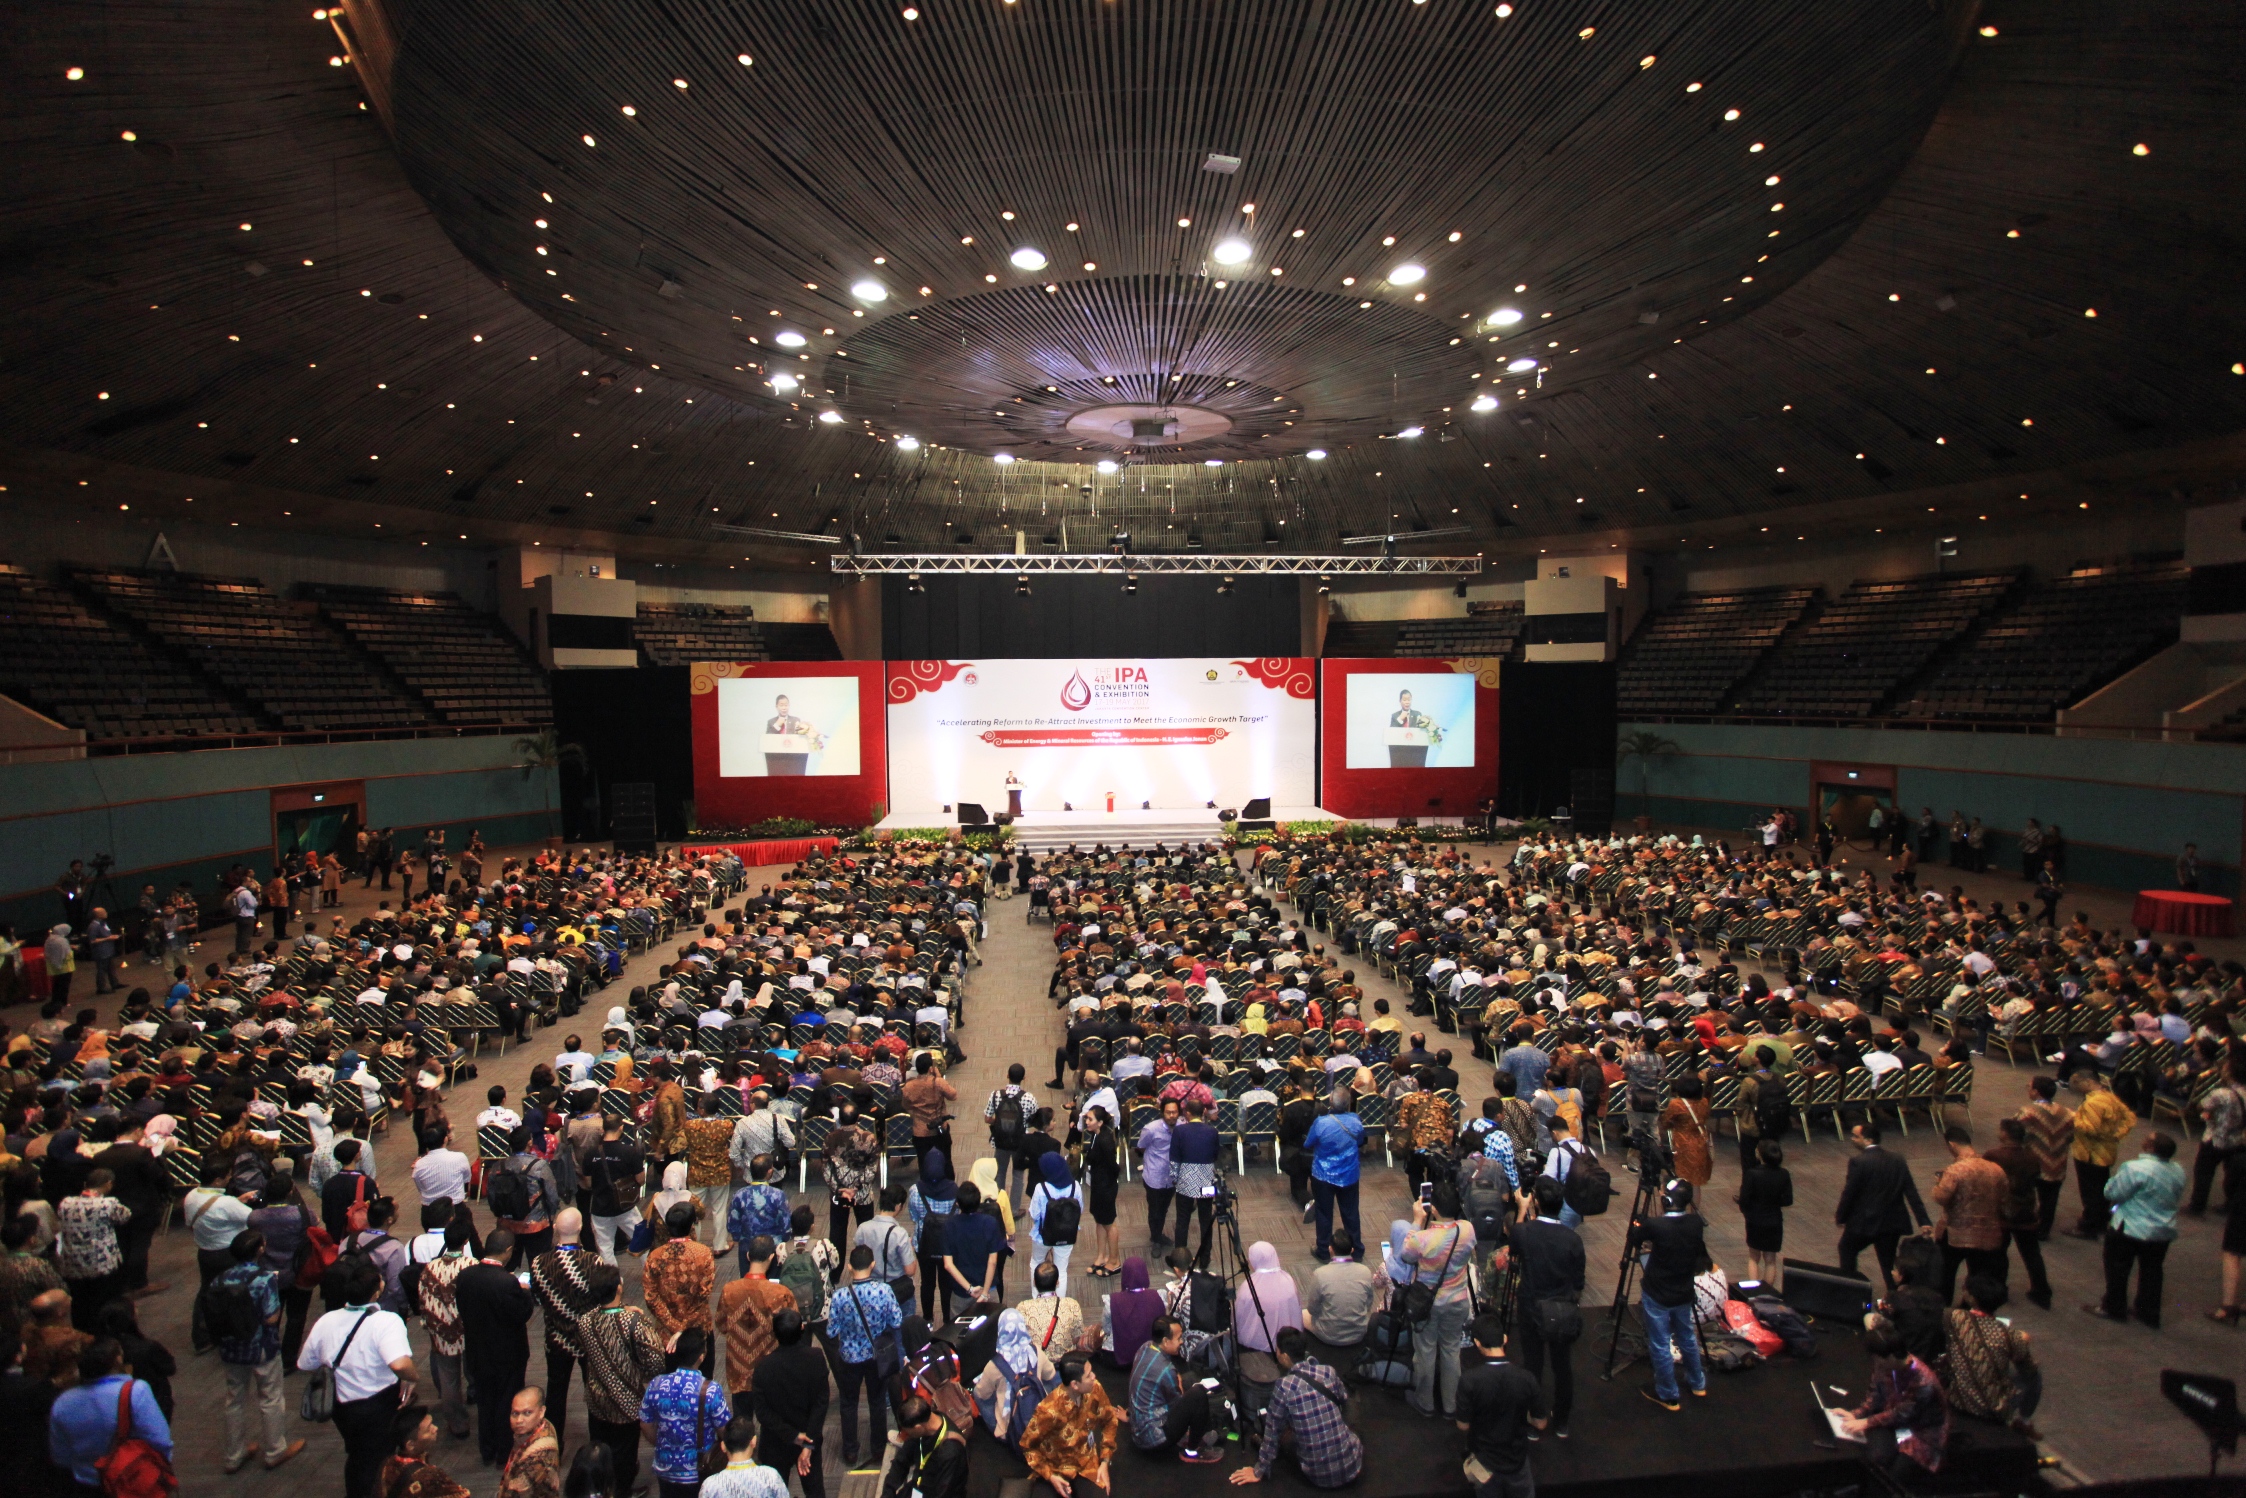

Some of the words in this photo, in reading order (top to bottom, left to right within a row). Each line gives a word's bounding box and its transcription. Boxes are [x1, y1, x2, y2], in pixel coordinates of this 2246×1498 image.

[145, 532, 180, 572] A
[1094, 667, 1111, 676] THE
[1115, 667, 1148, 682] IPA
[994, 718, 1024, 727] Reform
